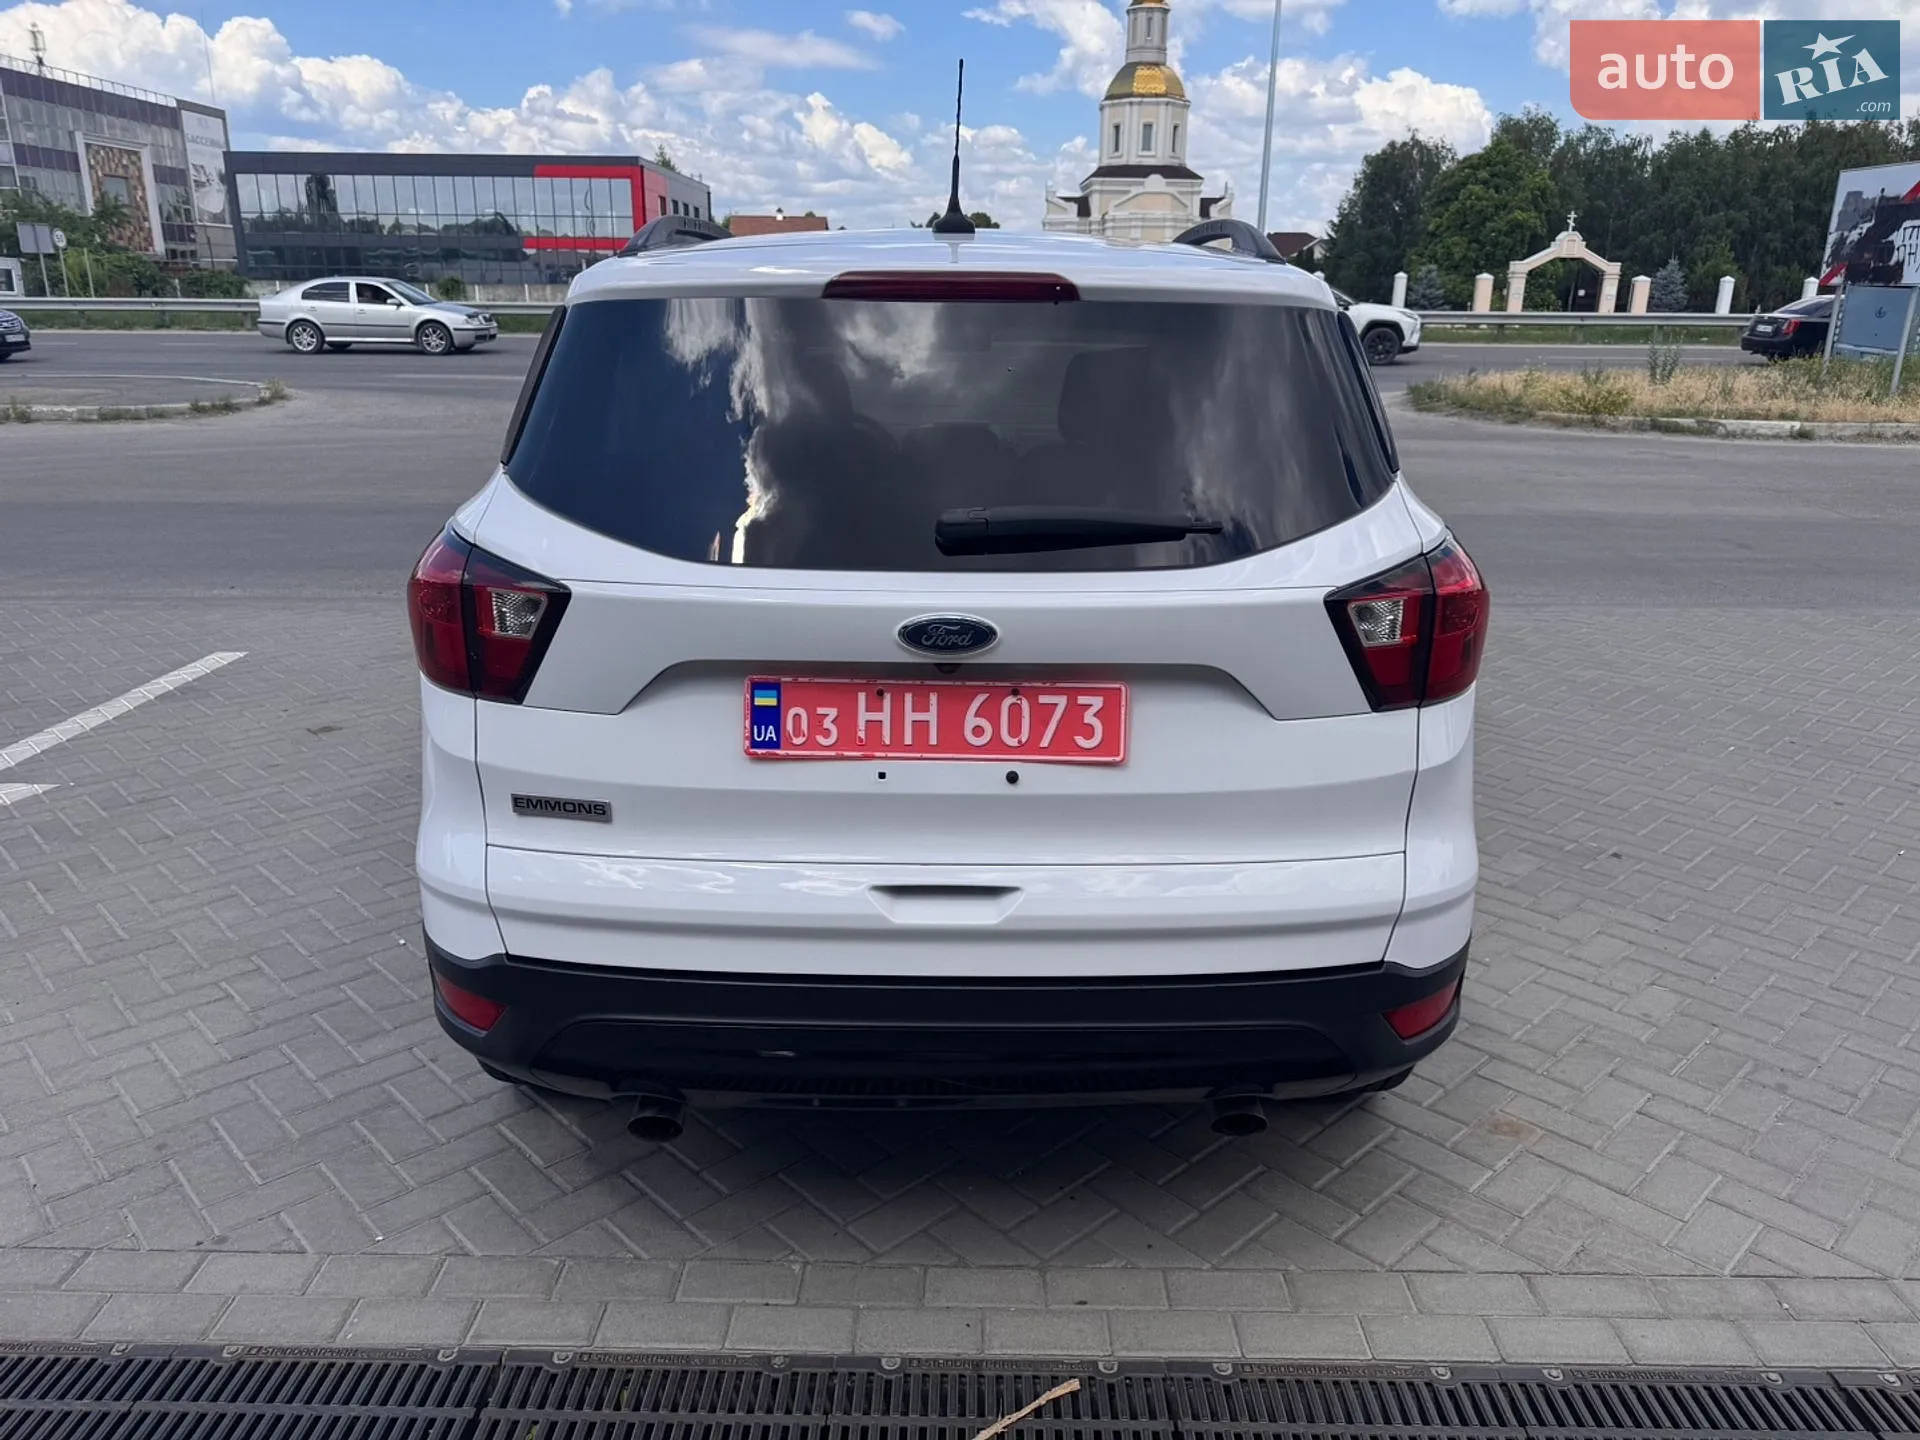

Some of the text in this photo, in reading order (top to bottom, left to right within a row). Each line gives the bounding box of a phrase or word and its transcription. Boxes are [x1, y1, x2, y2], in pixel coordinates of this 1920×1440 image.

[921, 624, 975, 646] Ford
[753, 691, 1105, 750] UA 03 HH 6073
[513, 797, 607, 816] EMMONS
